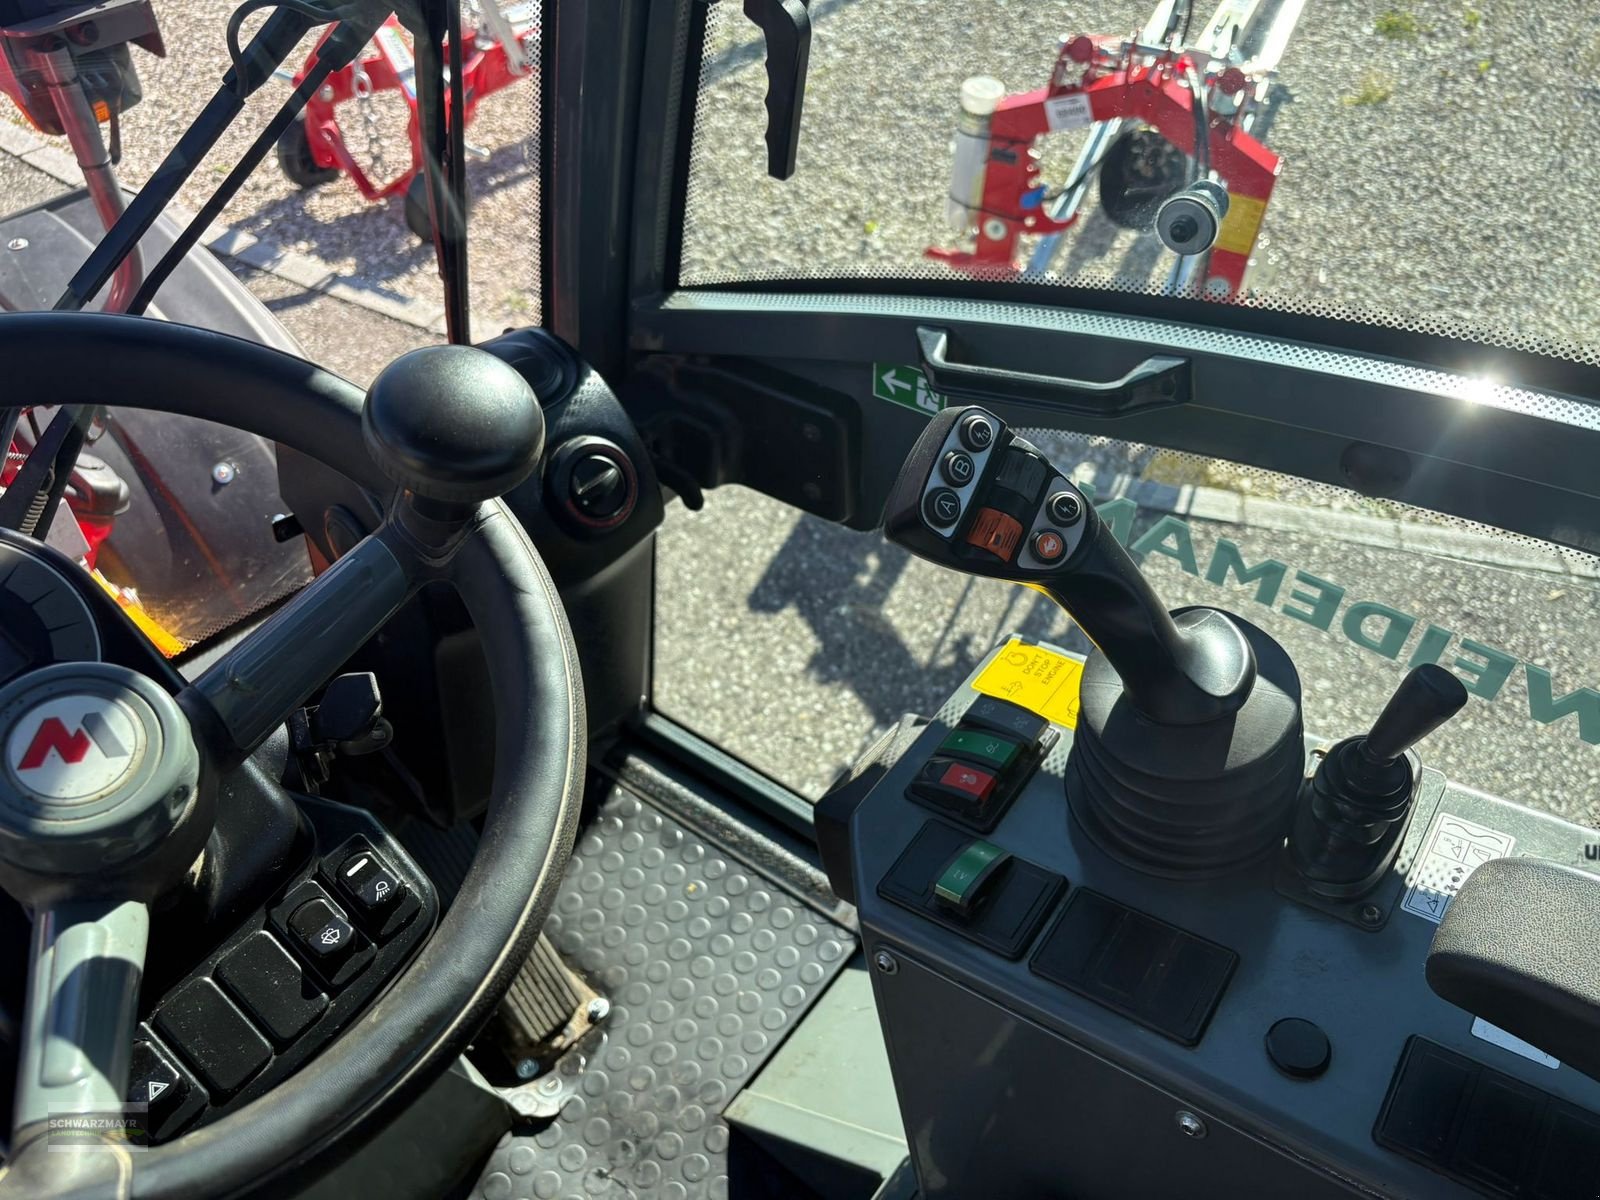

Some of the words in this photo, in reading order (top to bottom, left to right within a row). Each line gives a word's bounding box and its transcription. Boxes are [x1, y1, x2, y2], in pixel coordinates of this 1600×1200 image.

[954, 459, 970, 476] B
[940, 500, 956, 515] A
[1034, 659, 1051, 678] STOP
[1041, 659, 1065, 686] ENGINE
